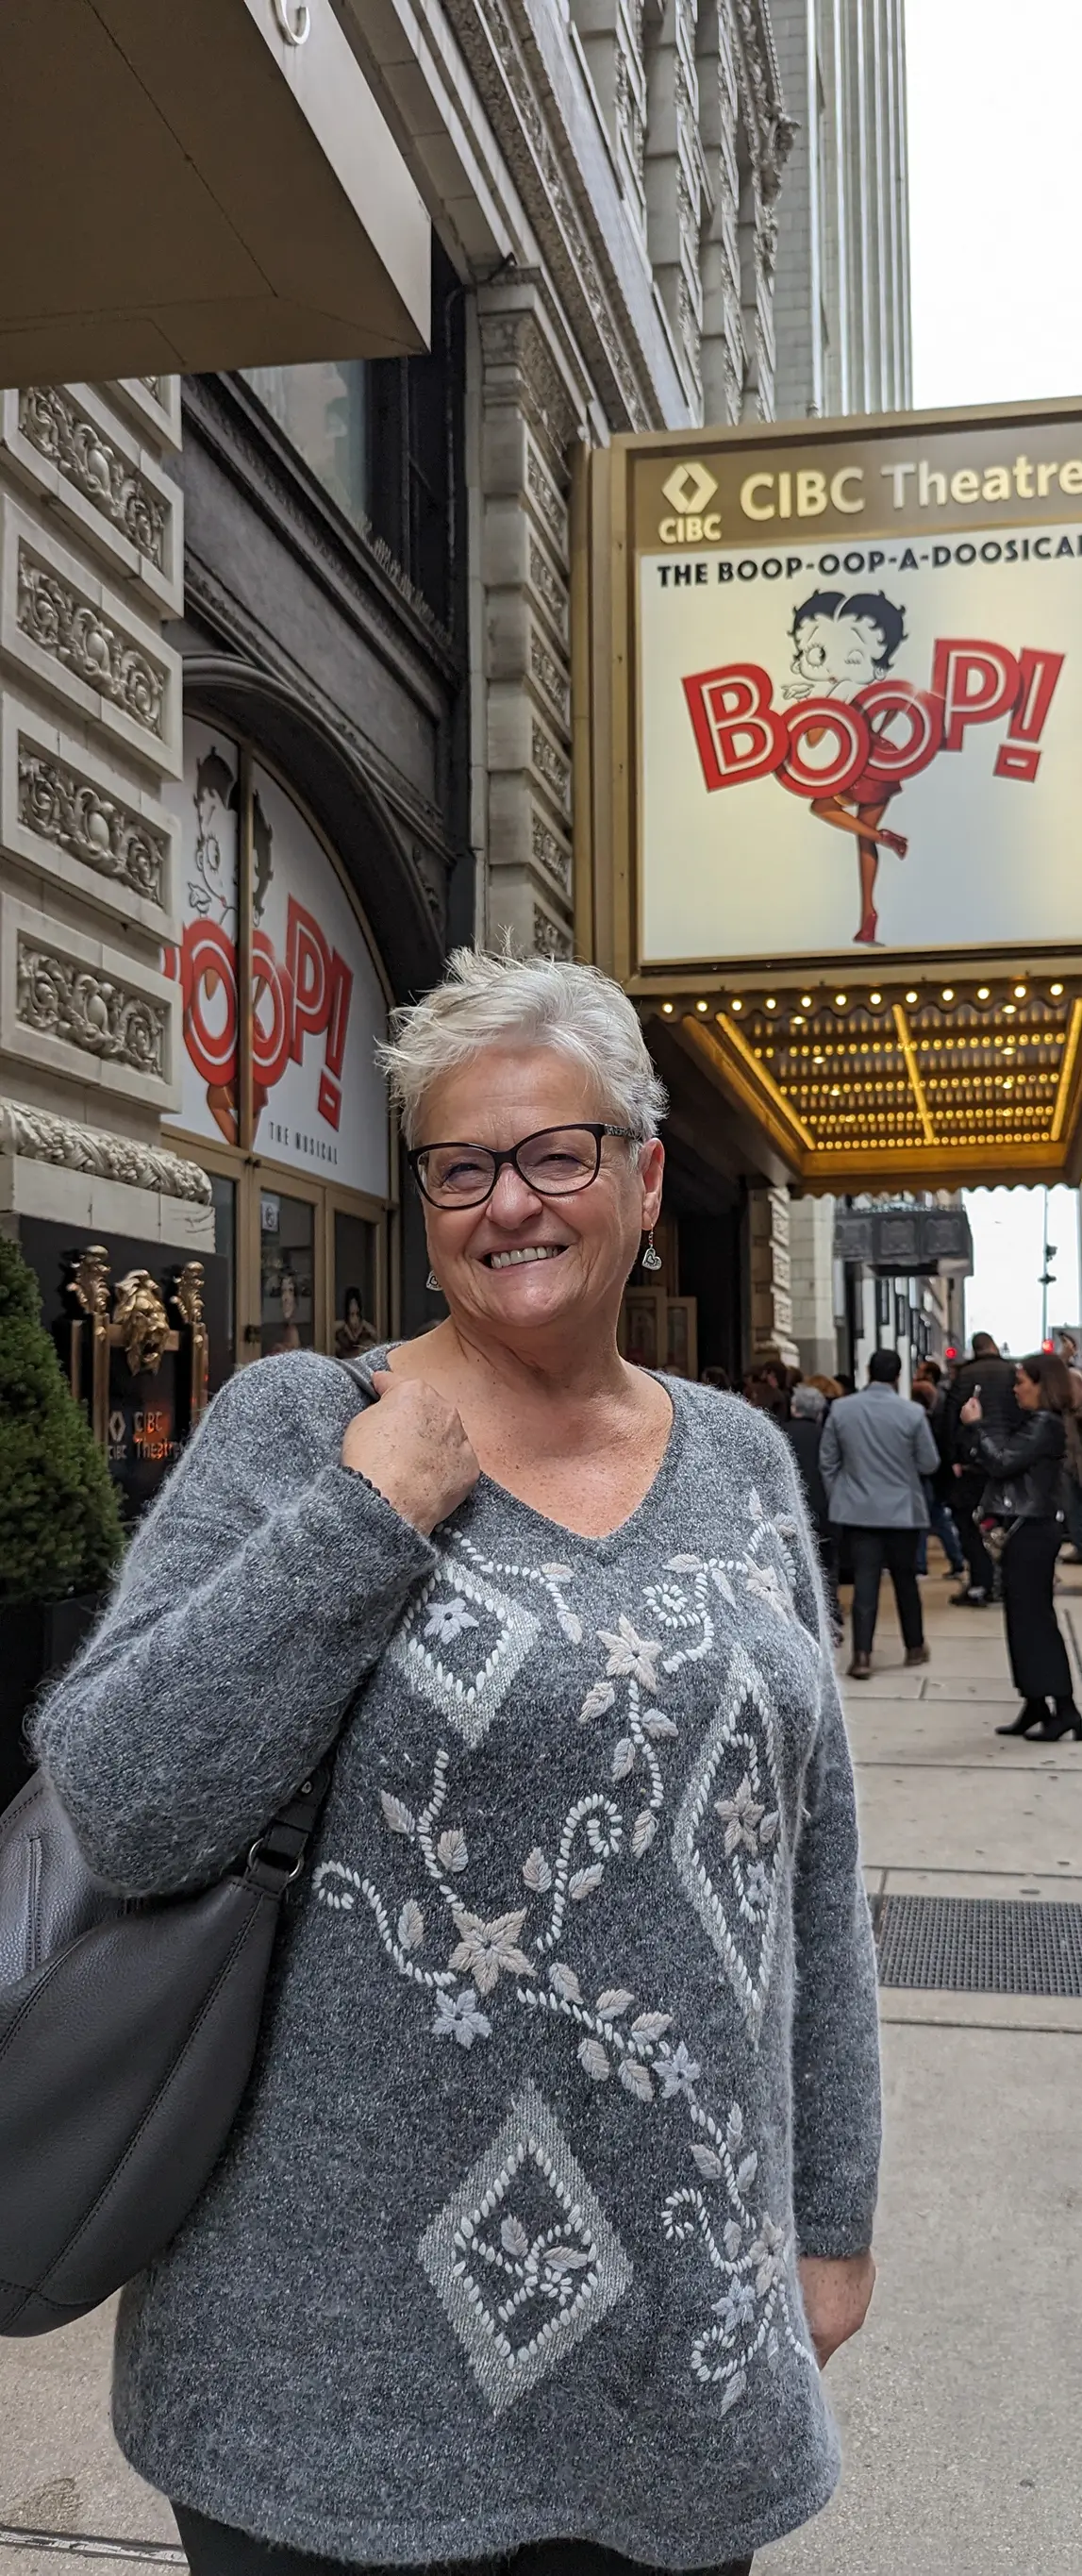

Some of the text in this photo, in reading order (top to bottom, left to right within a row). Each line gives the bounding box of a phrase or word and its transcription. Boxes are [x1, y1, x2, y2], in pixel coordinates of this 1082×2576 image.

[740, 454, 1082, 521] CIBC Theatre
[658, 513, 722, 544] CIBC
[658, 563, 709, 587] THE
[160, 893, 354, 1131] OOP!
[270, 1121, 338, 1165] THE MUSICAL
[134, 1411, 163, 1433] CIBC
